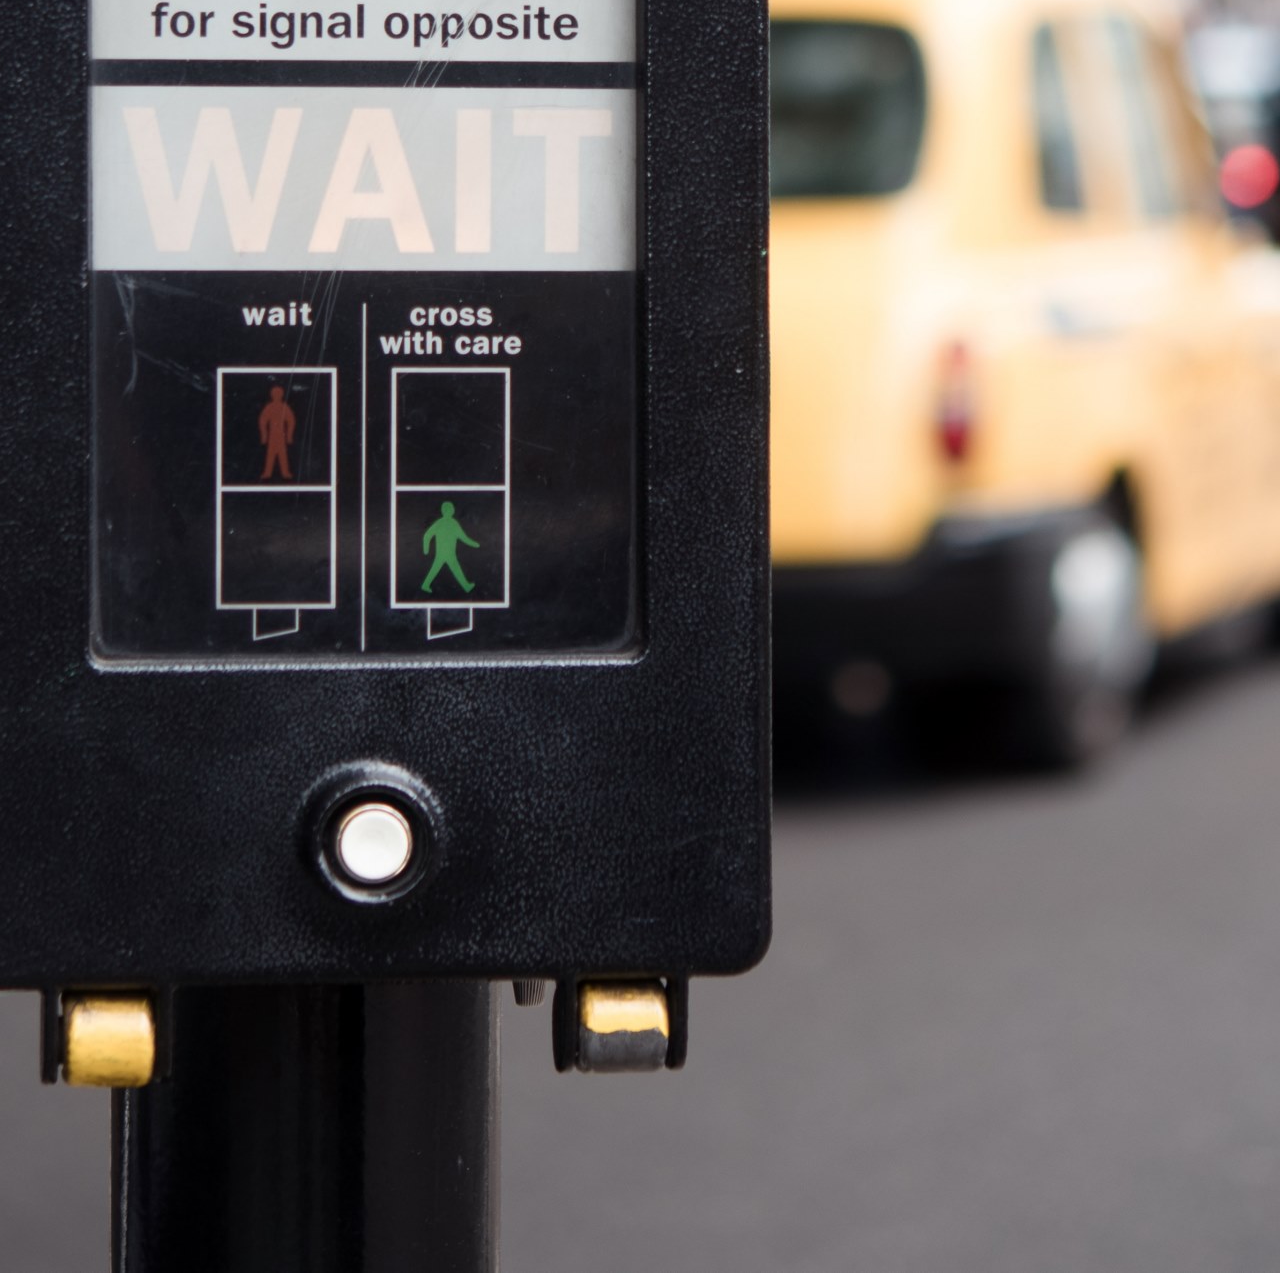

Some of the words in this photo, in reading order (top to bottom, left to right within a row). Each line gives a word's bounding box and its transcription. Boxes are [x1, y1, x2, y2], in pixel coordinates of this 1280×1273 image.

[151, 1, 215, 38] for
[232, 3, 365, 50] signal
[384, 6, 579, 48] opposite
[122, 106, 613, 254] WAIT
[242, 303, 312, 326] wait
[409, 307, 493, 327] cross
[380, 330, 443, 355] with
[454, 335, 522, 355] care
